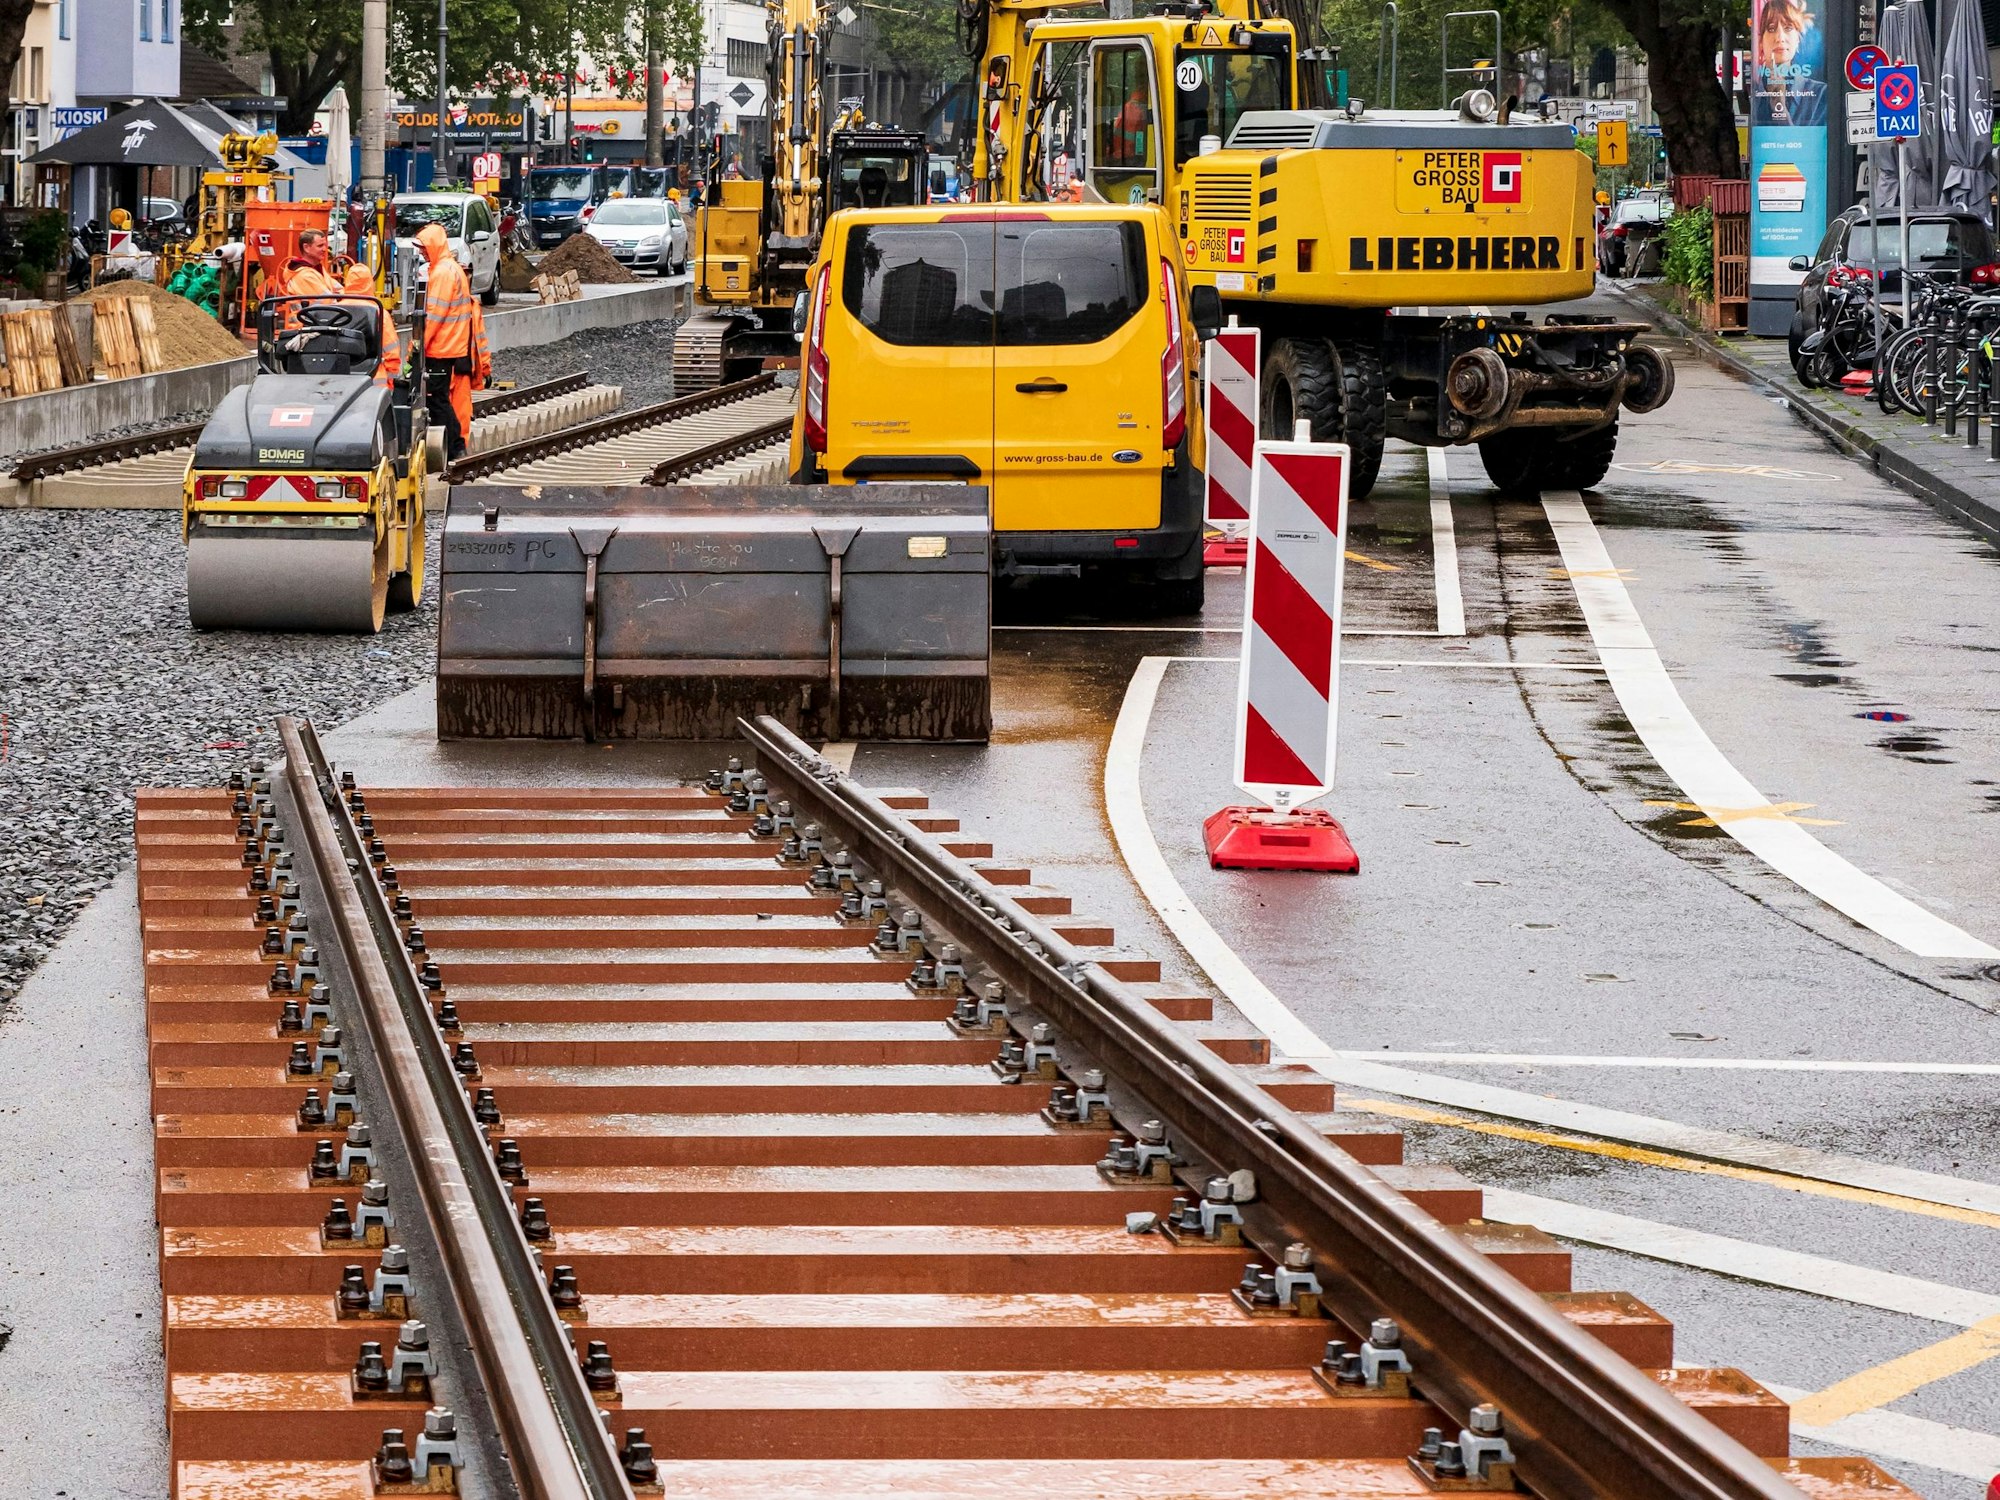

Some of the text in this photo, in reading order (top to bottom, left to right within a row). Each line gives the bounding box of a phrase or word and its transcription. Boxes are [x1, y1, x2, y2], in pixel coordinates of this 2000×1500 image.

[1181, 67, 1196, 85] 20
[57, 111, 103, 125] KIOSK
[467, 112, 523, 126] POTATO
[1880, 115, 1915, 131] TAXI
[1605, 126, 1613, 136] U
[1424, 152, 1480, 168] PETER
[1413, 170, 1480, 186] GROSS
[1443, 187, 1480, 204] BAU
[1204, 227, 1227, 238] PETER
[1199, 239, 1227, 250] GROSS
[1210, 252, 1227, 262] BAU
[1349, 236, 1561, 271] LIEBHERR
[259, 449, 305, 459] BOMAG
[1004, 453, 1103, 465] www.gross-bau.de
[1119, 452, 1137, 461] Ford
